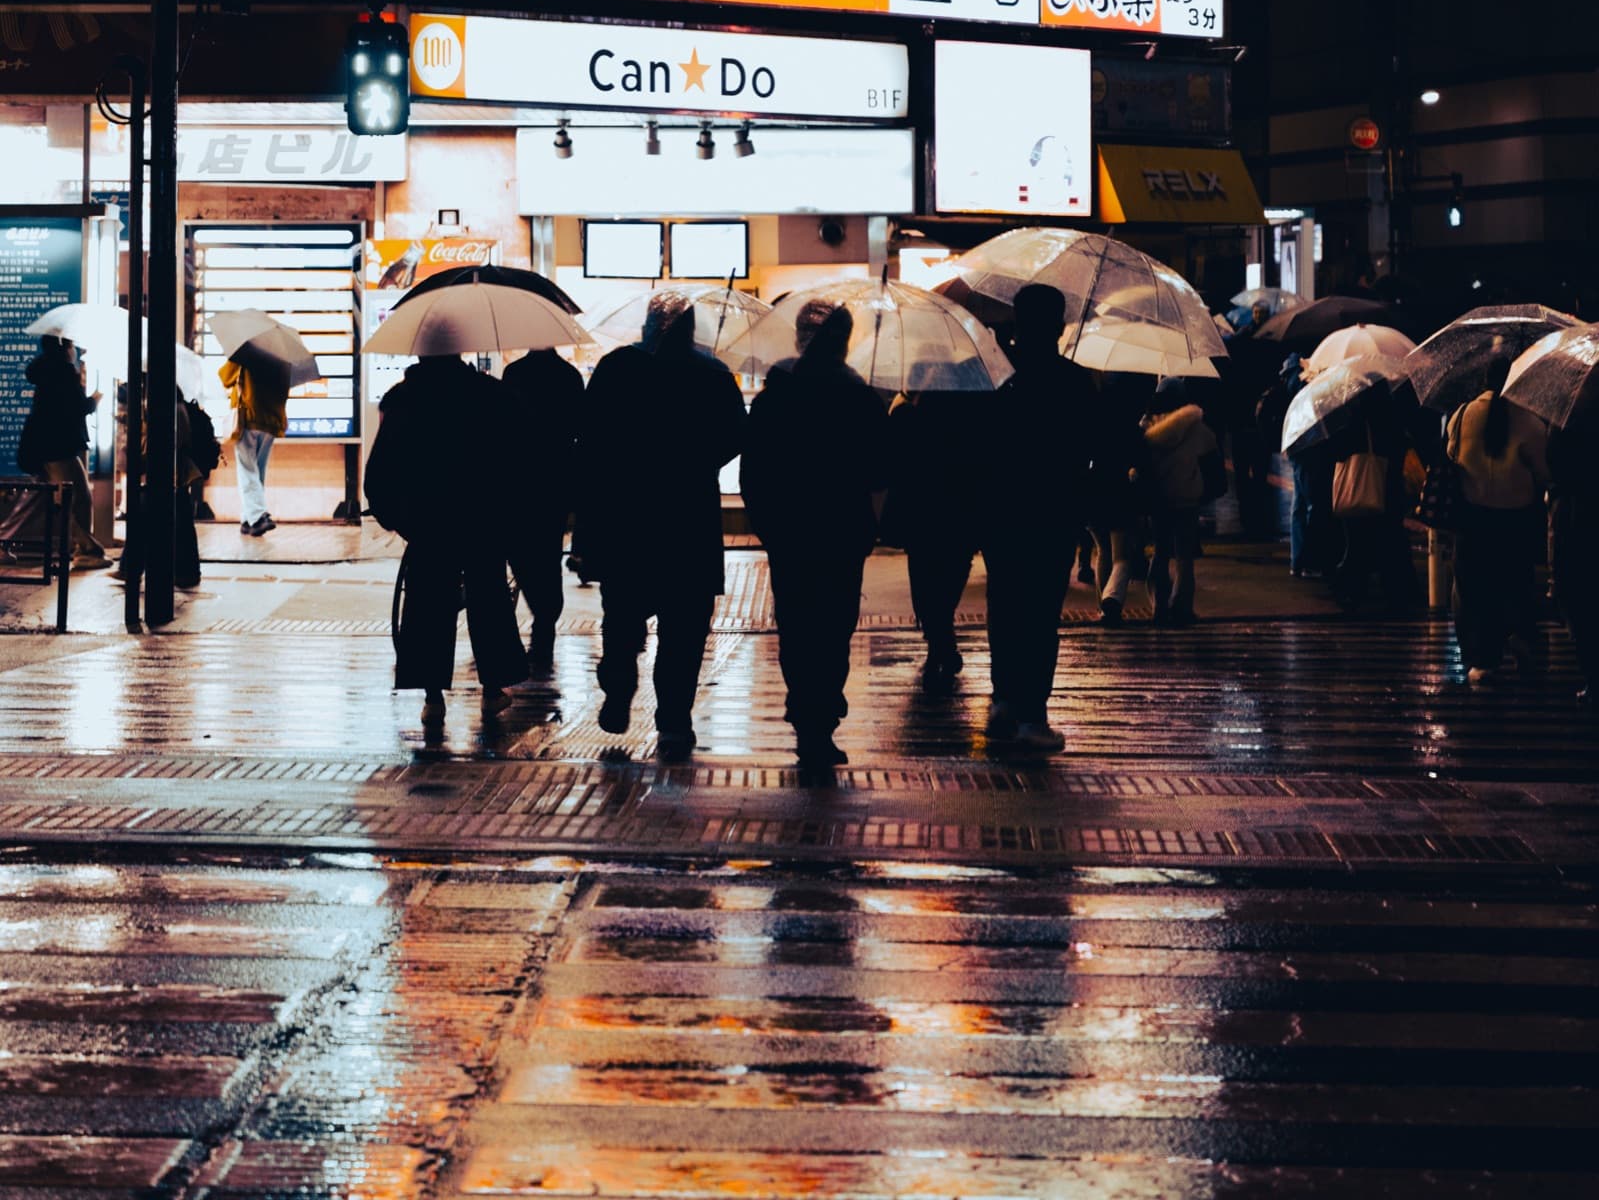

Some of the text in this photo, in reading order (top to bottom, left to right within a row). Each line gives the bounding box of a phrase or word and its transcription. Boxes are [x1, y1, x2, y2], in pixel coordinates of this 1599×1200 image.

[1188, 7, 1216, 30] 3分
[423, 37, 452, 68] 100
[589, 49, 776, 98] Can Do
[867, 88, 902, 109] B1F
[178, 134, 373, 174] 店ビル
[1141, 168, 1227, 200] RELX
